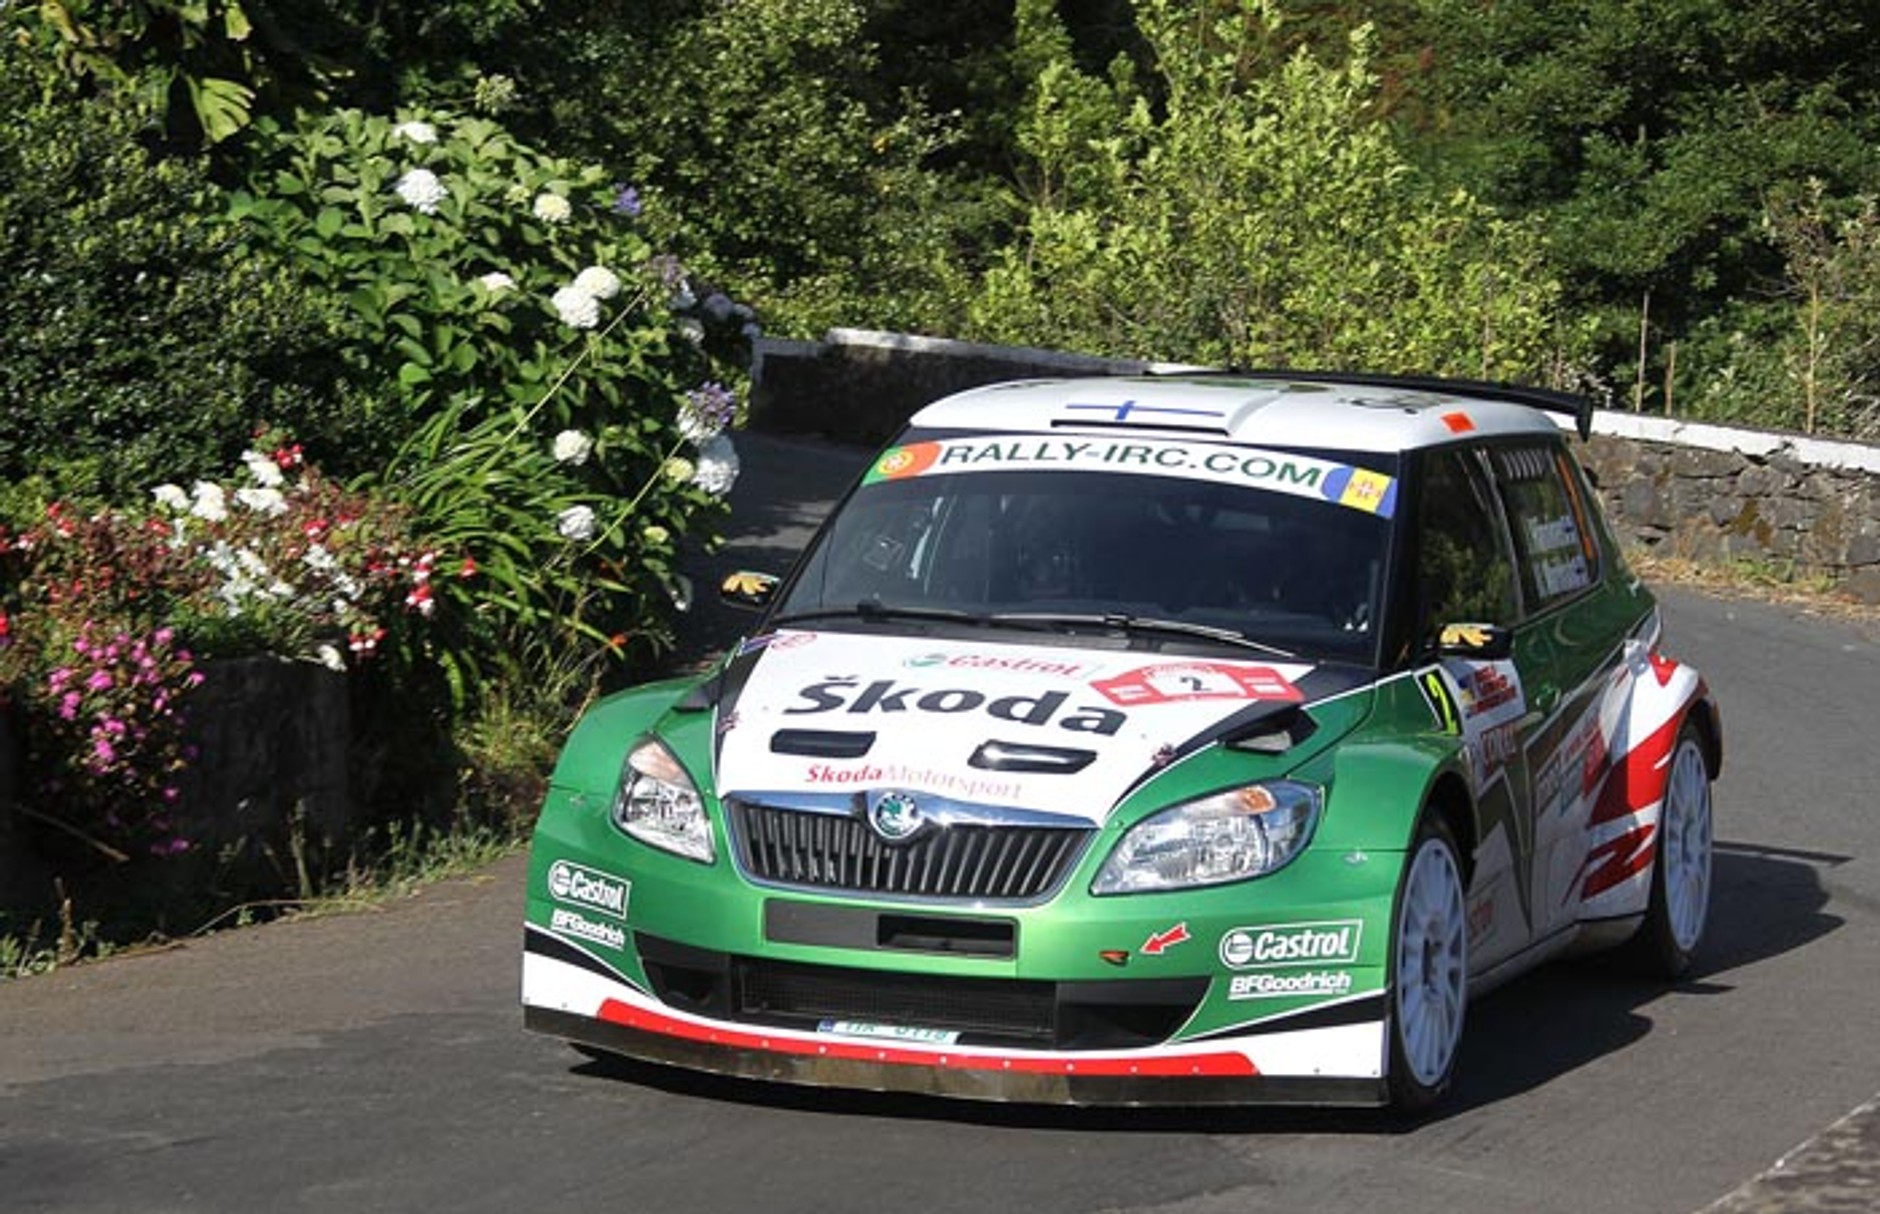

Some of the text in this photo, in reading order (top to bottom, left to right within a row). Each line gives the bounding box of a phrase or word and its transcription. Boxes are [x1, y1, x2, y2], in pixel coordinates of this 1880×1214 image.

[940, 442, 1321, 488] RALLY-IRC.COM
[949, 654, 1081, 676] Castrol
[1179, 676, 1213, 692] 2
[782, 675, 1130, 736] Škoda
[570, 870, 624, 911] Castrol
[551, 908, 625, 946] BFGoodrich
[1254, 927, 1350, 960] Castrol
[1230, 970, 1351, 994] BFGoodrich
